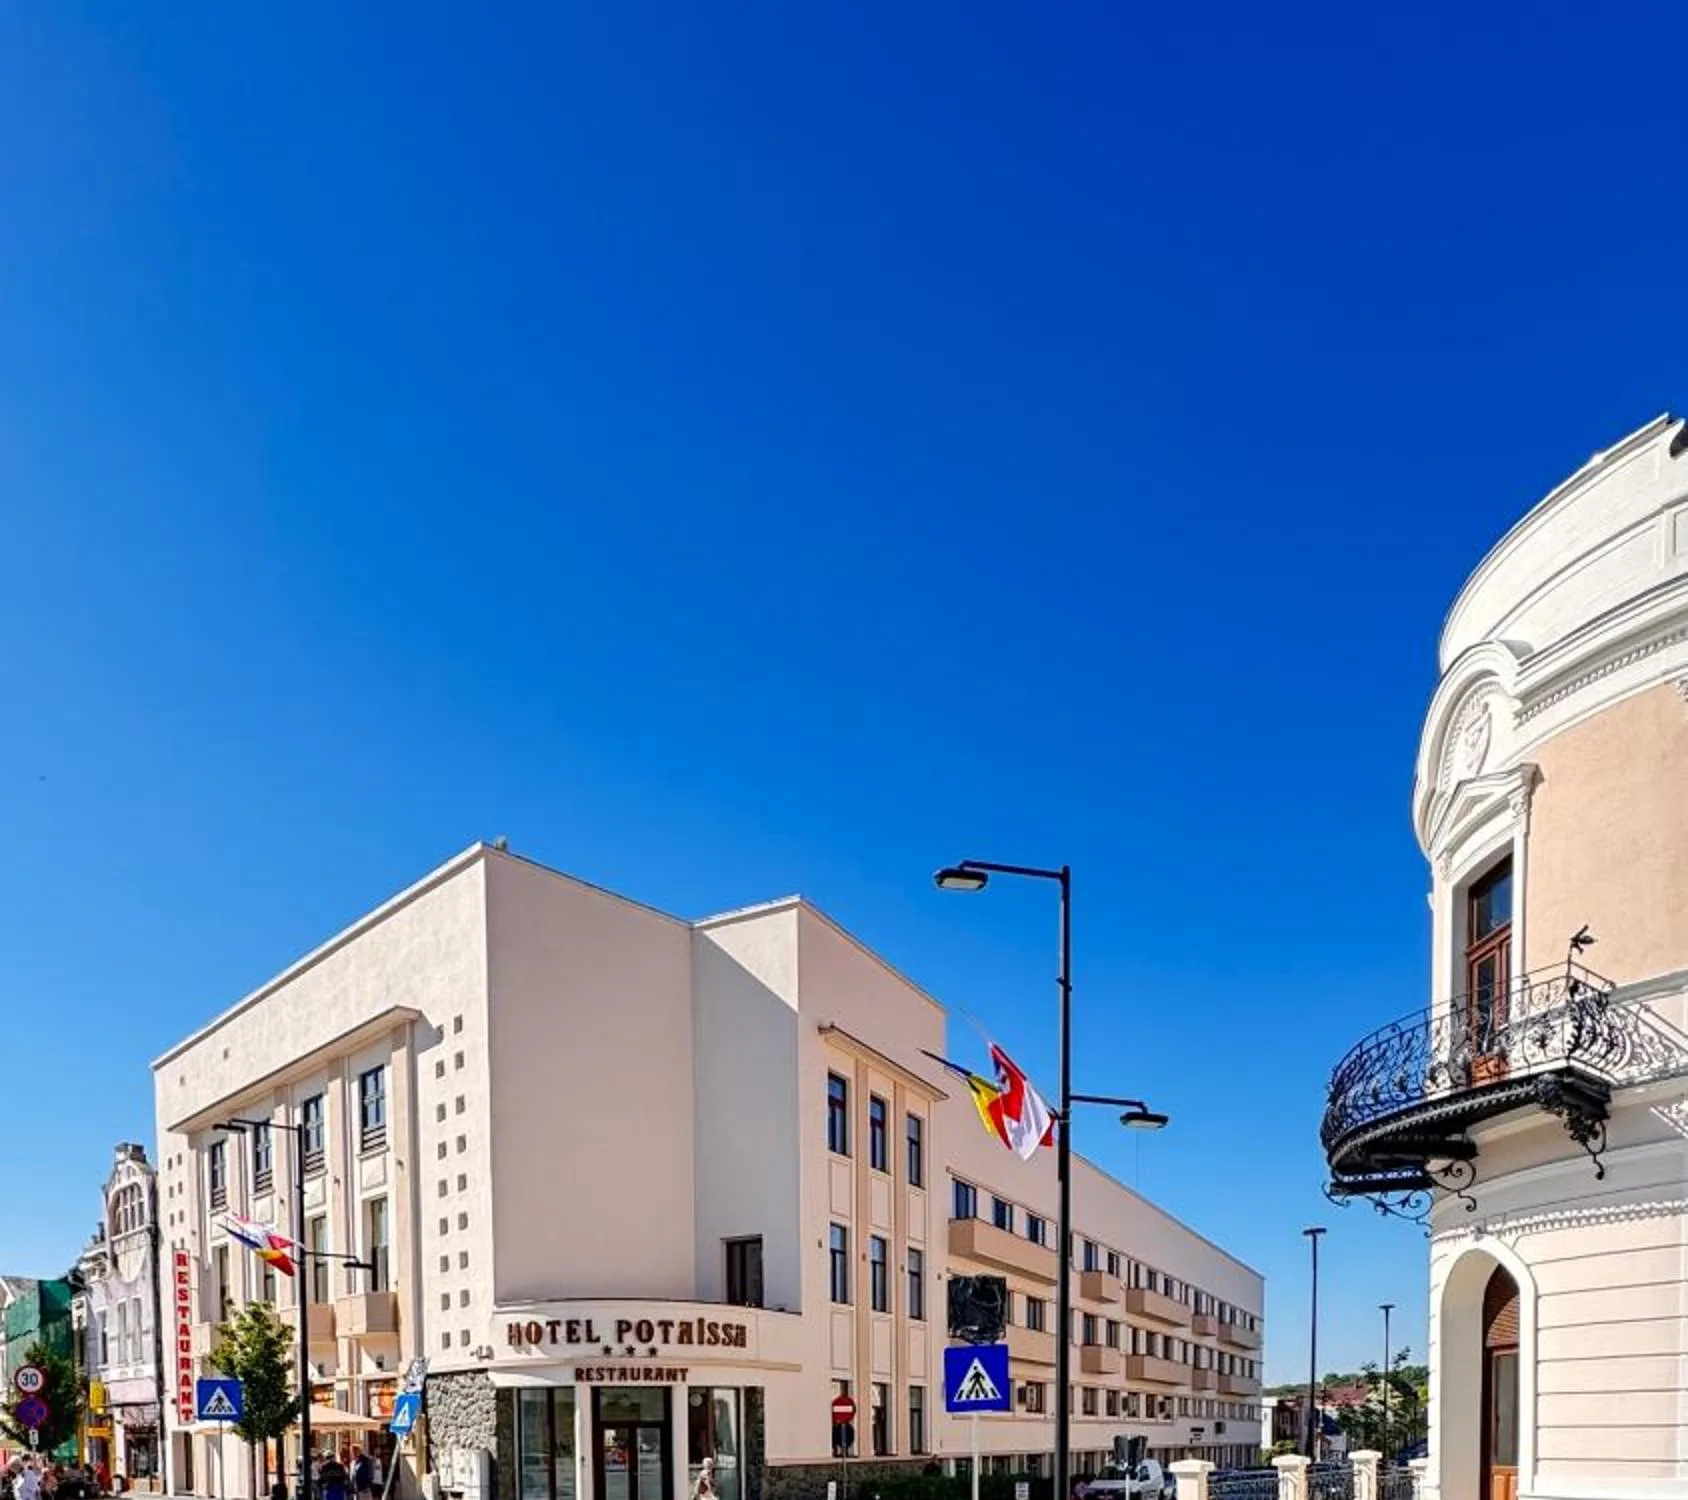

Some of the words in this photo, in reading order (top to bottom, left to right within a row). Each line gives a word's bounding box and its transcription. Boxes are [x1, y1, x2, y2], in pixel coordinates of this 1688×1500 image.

[175, 1253, 193, 1421] RESTAURANT
[507, 1319, 601, 1346] HOTEL
[21, 1372, 39, 1387] 30
[575, 1367, 689, 1383] RESTAURANT
